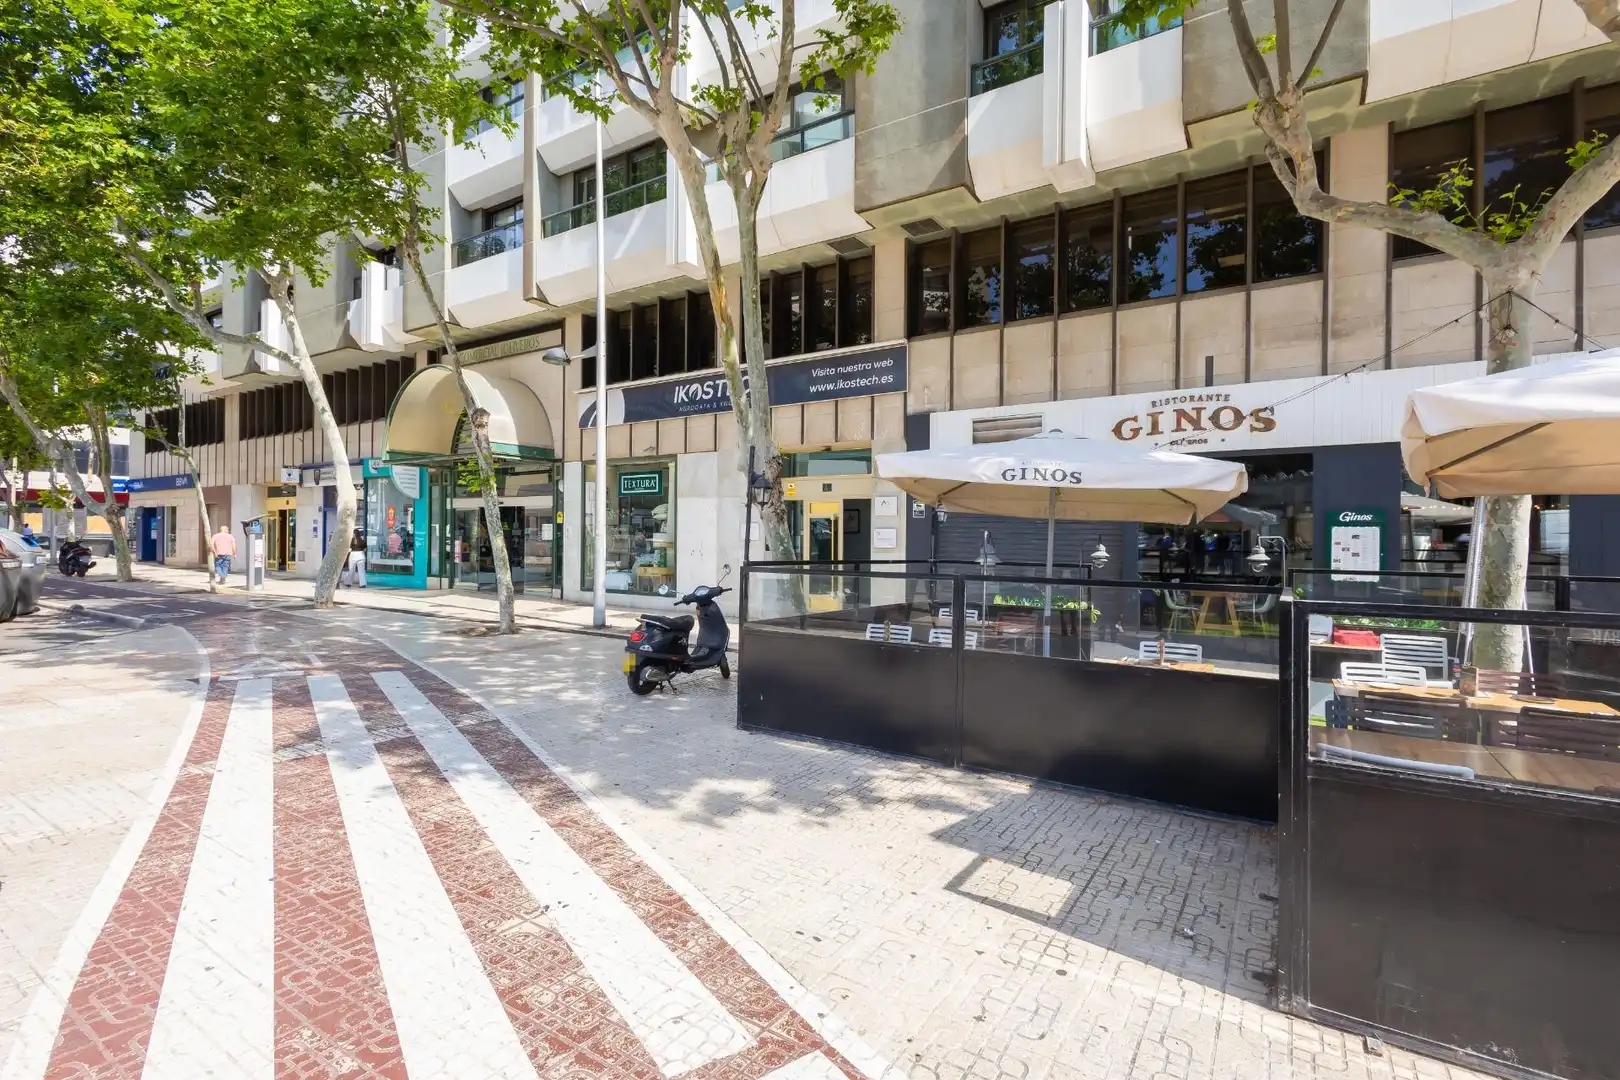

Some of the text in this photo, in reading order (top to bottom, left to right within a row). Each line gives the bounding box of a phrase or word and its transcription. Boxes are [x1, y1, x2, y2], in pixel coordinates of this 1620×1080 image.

[812, 357, 894, 377] Visita nuestra web
[674, 376, 751, 404] IKOST
[809, 373, 894, 393] www.ikostech.es
[1151, 393, 1231, 409] RISTORANTE
[1111, 405, 1277, 441] GINOS
[624, 479, 656, 489] TEXTURA
[1001, 467, 1082, 484] GINOS
[1339, 511, 1374, 522] Ginos
